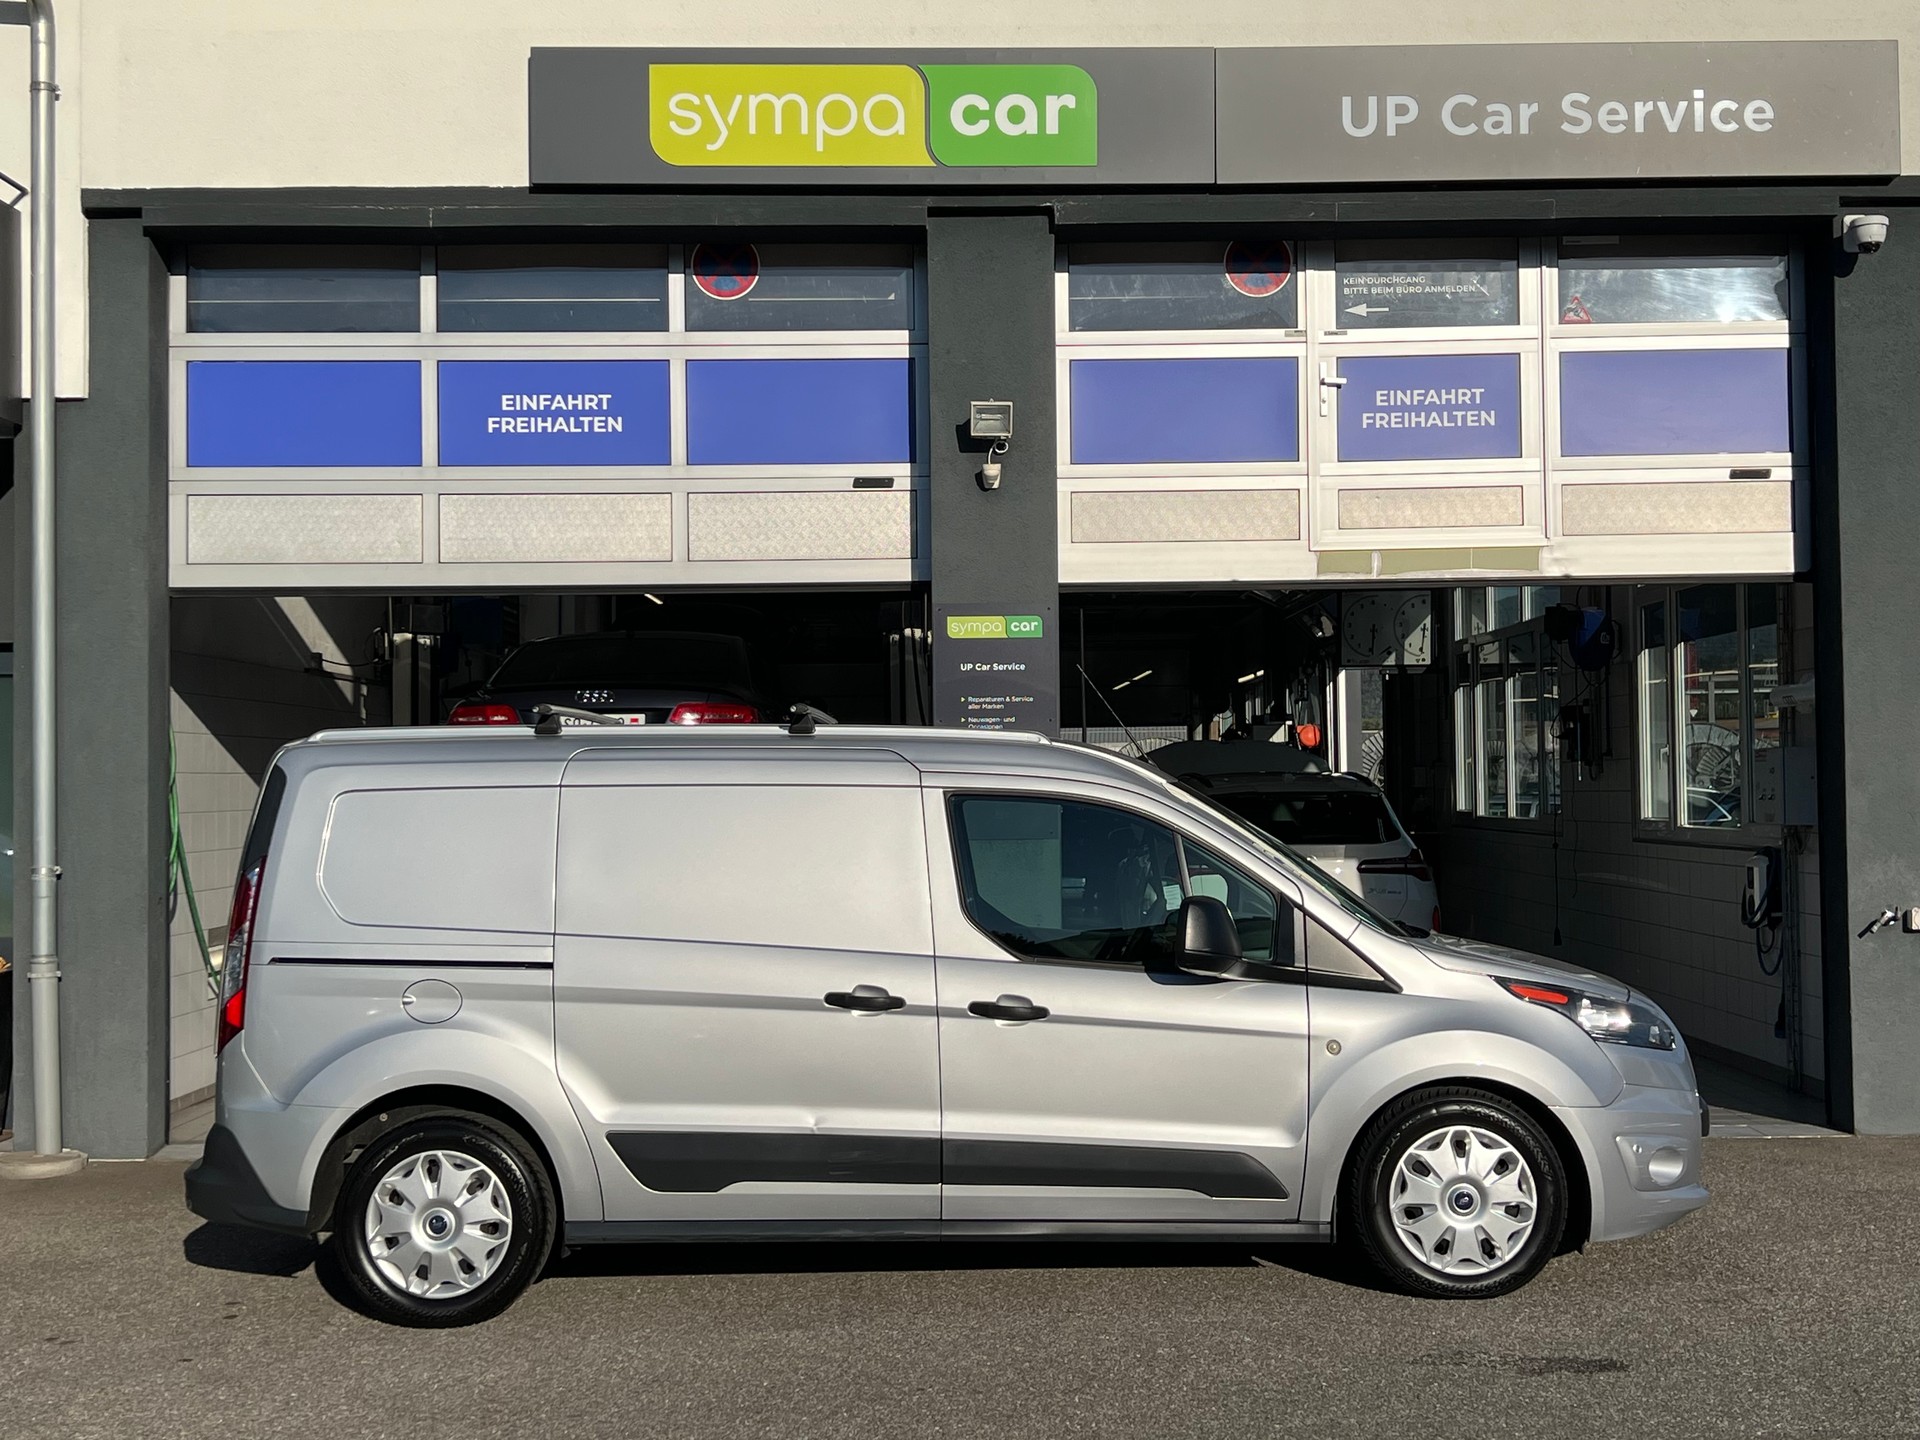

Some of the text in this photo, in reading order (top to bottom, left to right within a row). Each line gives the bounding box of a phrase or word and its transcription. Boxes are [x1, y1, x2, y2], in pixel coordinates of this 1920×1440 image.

[1341, 88, 1775, 138] UP Car Service
[668, 92, 1077, 152] sympa car
[1343, 275, 1426, 285] KEIN DURCHGANG
[1343, 285, 1476, 295] BITTE BEIM BÜRO ANMELDEN
[501, 394, 612, 411] EINFAHRT
[1375, 388, 1485, 406] EINFAHRT
[487, 416, 623, 433] FREIHALTEN
[1362, 410, 1496, 429] FREIHALTEN
[951, 621, 1039, 635] sympa car
[960, 662, 1026, 671] UP Car Service
